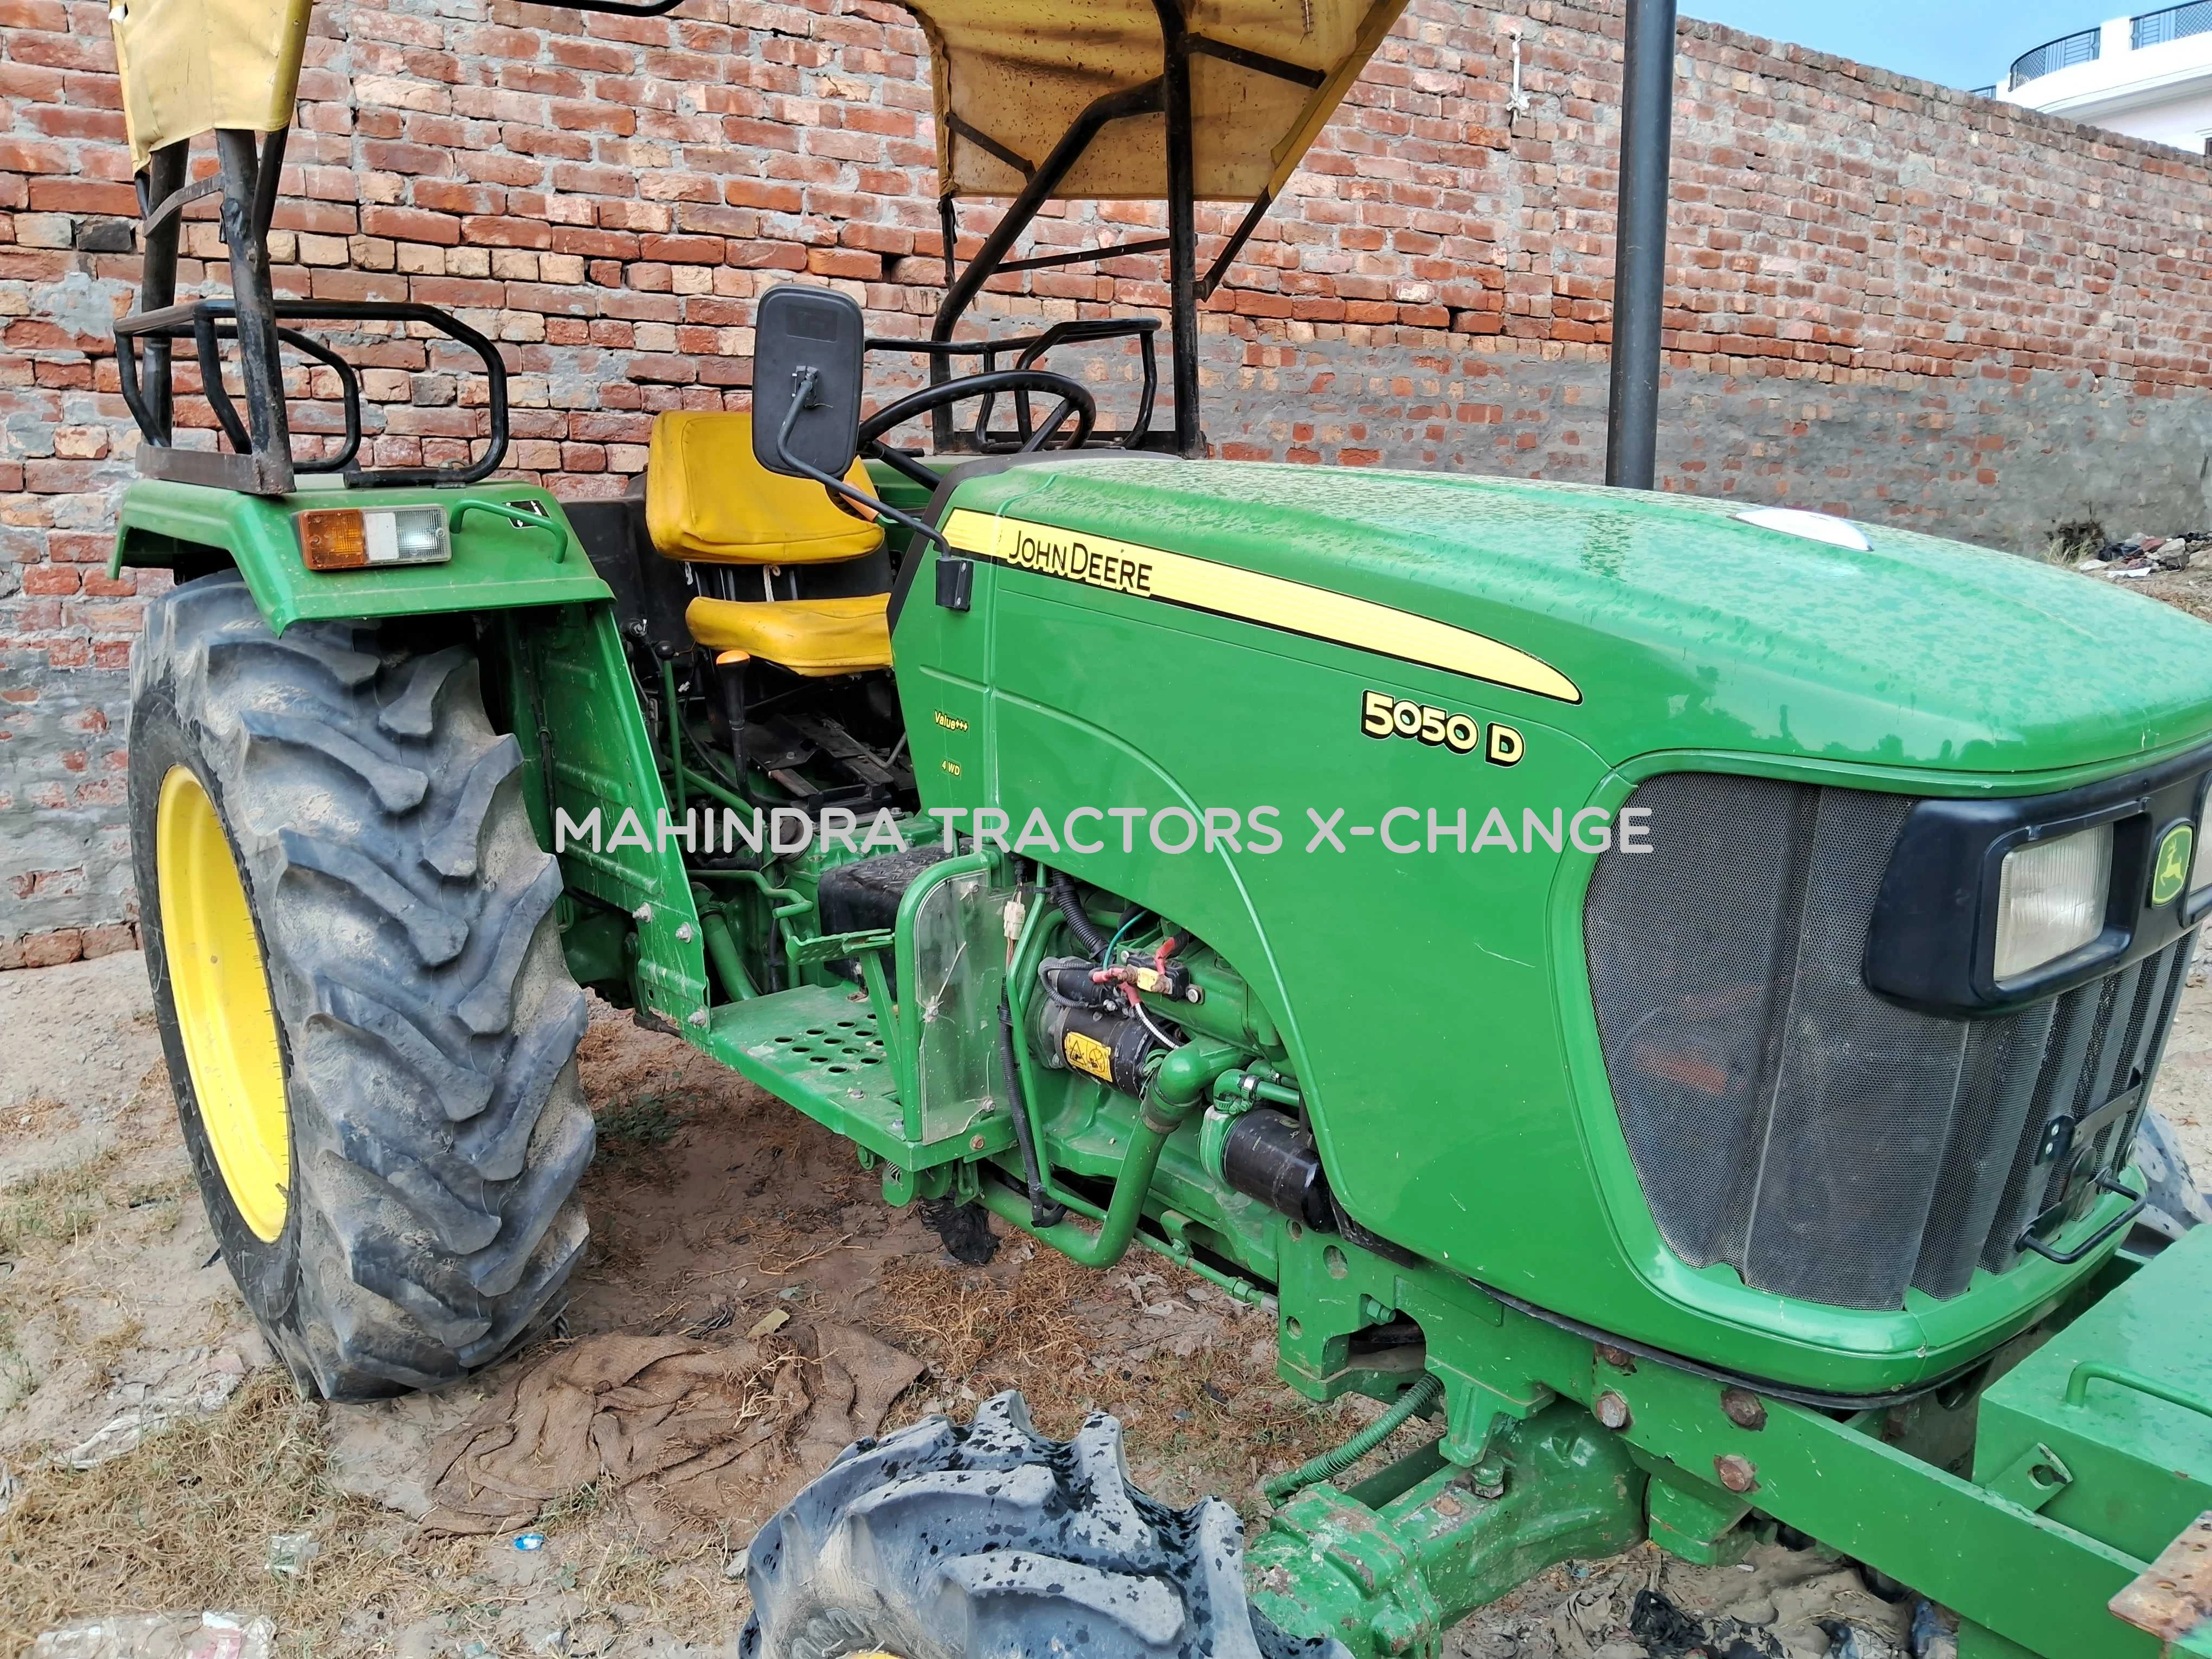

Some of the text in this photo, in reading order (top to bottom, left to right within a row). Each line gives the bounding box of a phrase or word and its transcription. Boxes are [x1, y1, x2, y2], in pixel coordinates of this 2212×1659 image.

[1009, 530, 1153, 592] JOHN DEERE
[934, 709, 968, 732] Value+++
[1361, 690, 1526, 768] 5050 D
[942, 760, 960, 776] 4 WD
